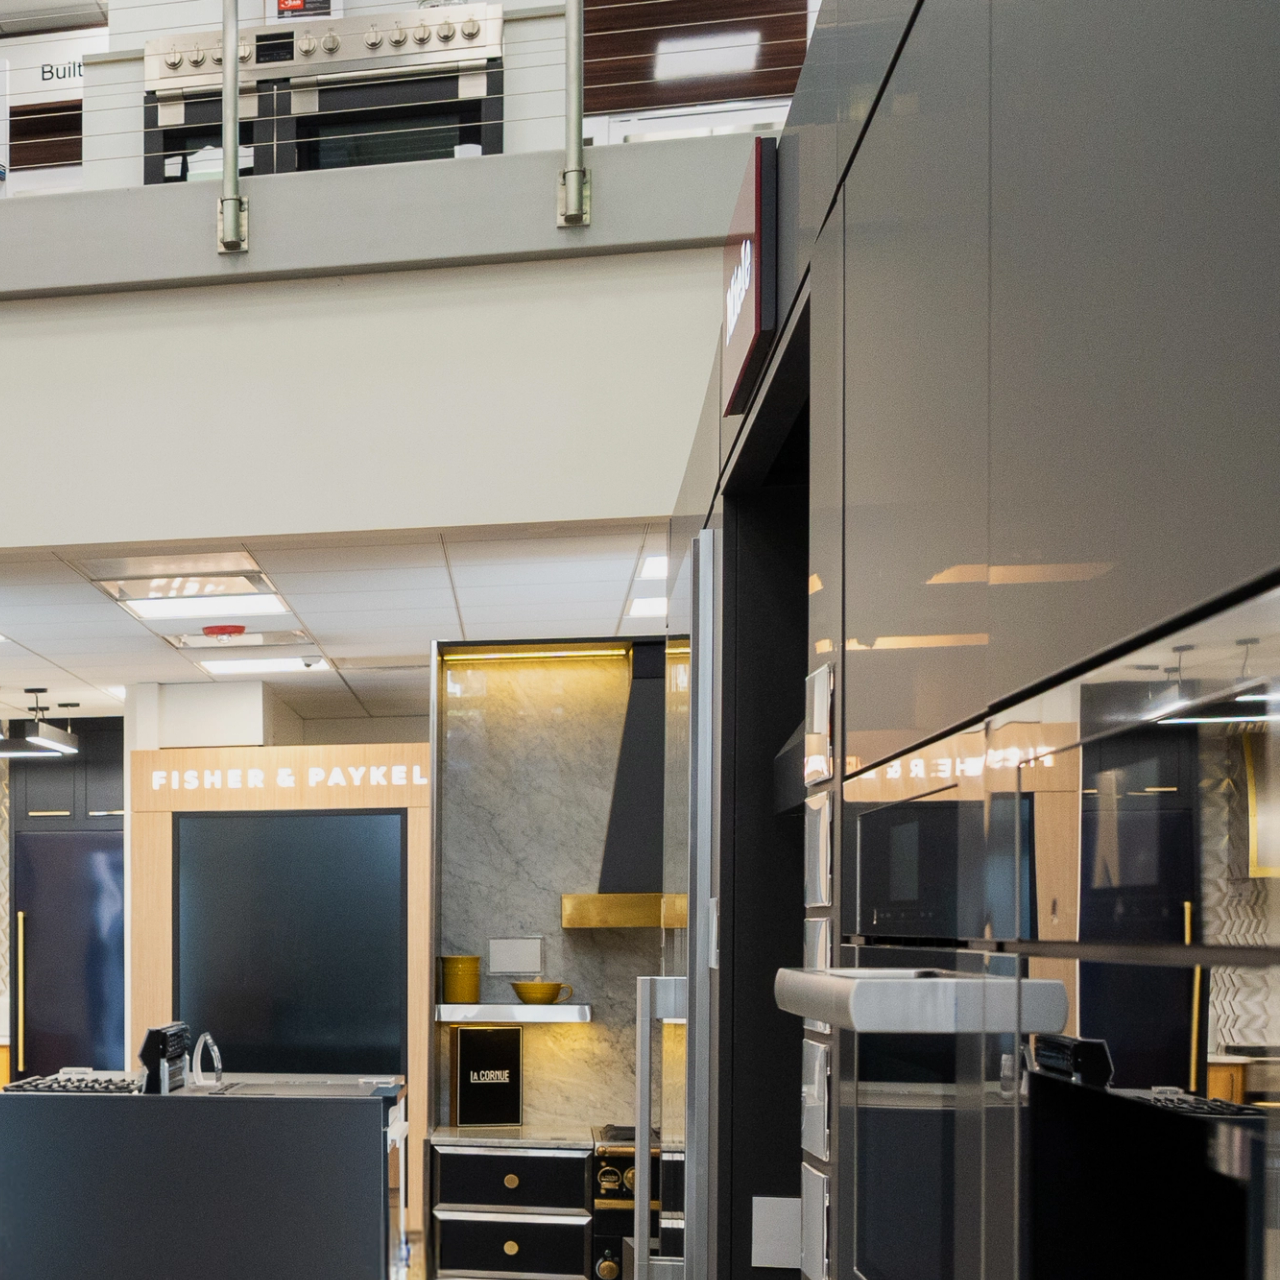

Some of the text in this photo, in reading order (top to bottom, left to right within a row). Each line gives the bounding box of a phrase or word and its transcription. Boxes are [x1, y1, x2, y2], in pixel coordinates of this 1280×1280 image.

[41, 61, 83, 81] Built
[151, 765, 428, 790] FISHER & PAYKEL
